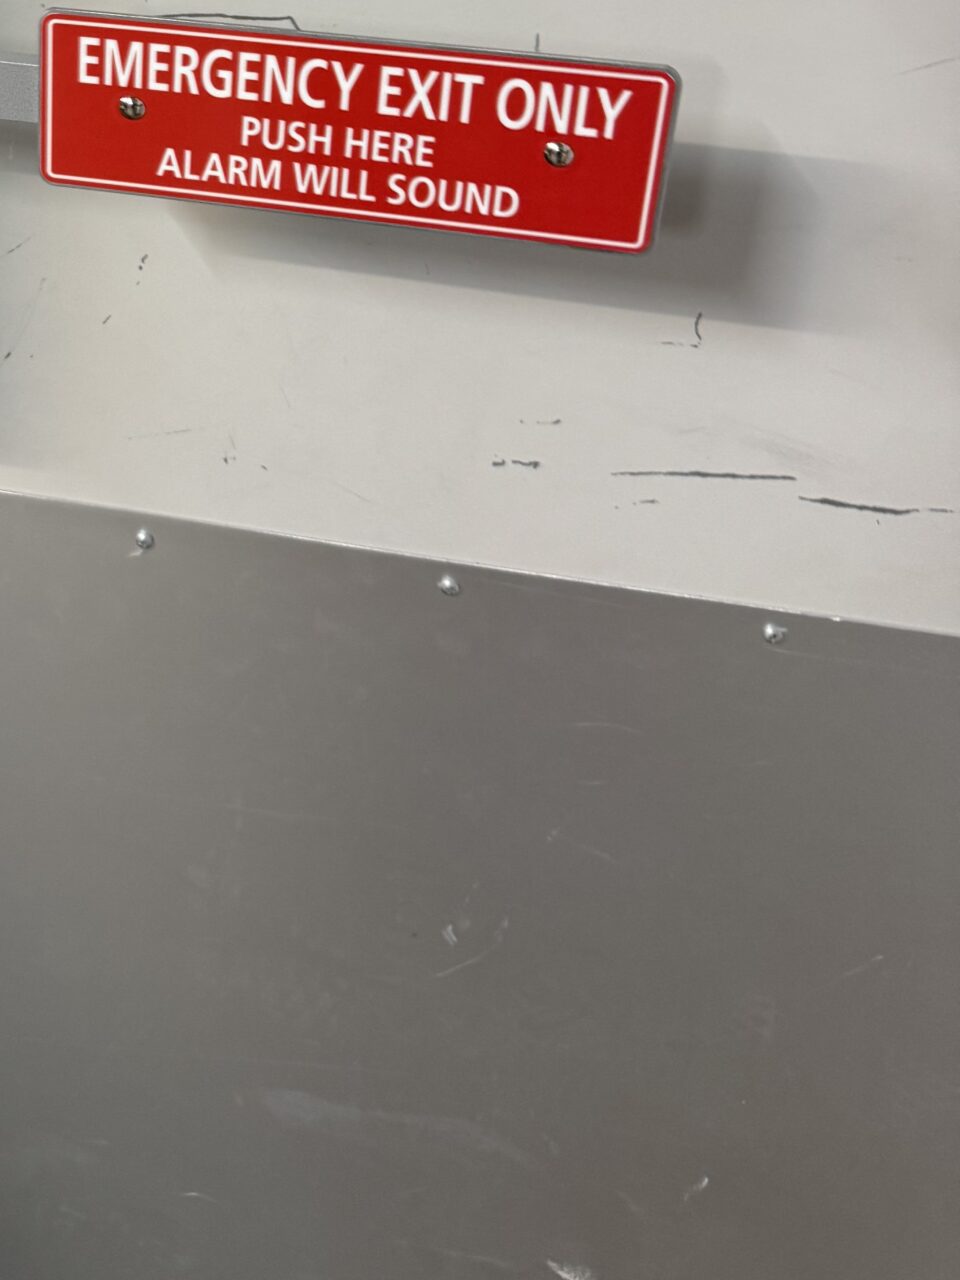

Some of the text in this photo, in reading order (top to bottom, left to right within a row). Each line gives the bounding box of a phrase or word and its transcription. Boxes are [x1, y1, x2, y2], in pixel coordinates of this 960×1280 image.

[77, 35, 633, 140] EMERGENCY EXIT ONLY
[240, 115, 436, 168] PUSH HERE
[155, 147, 520, 218] ALARM WILL SOUND
